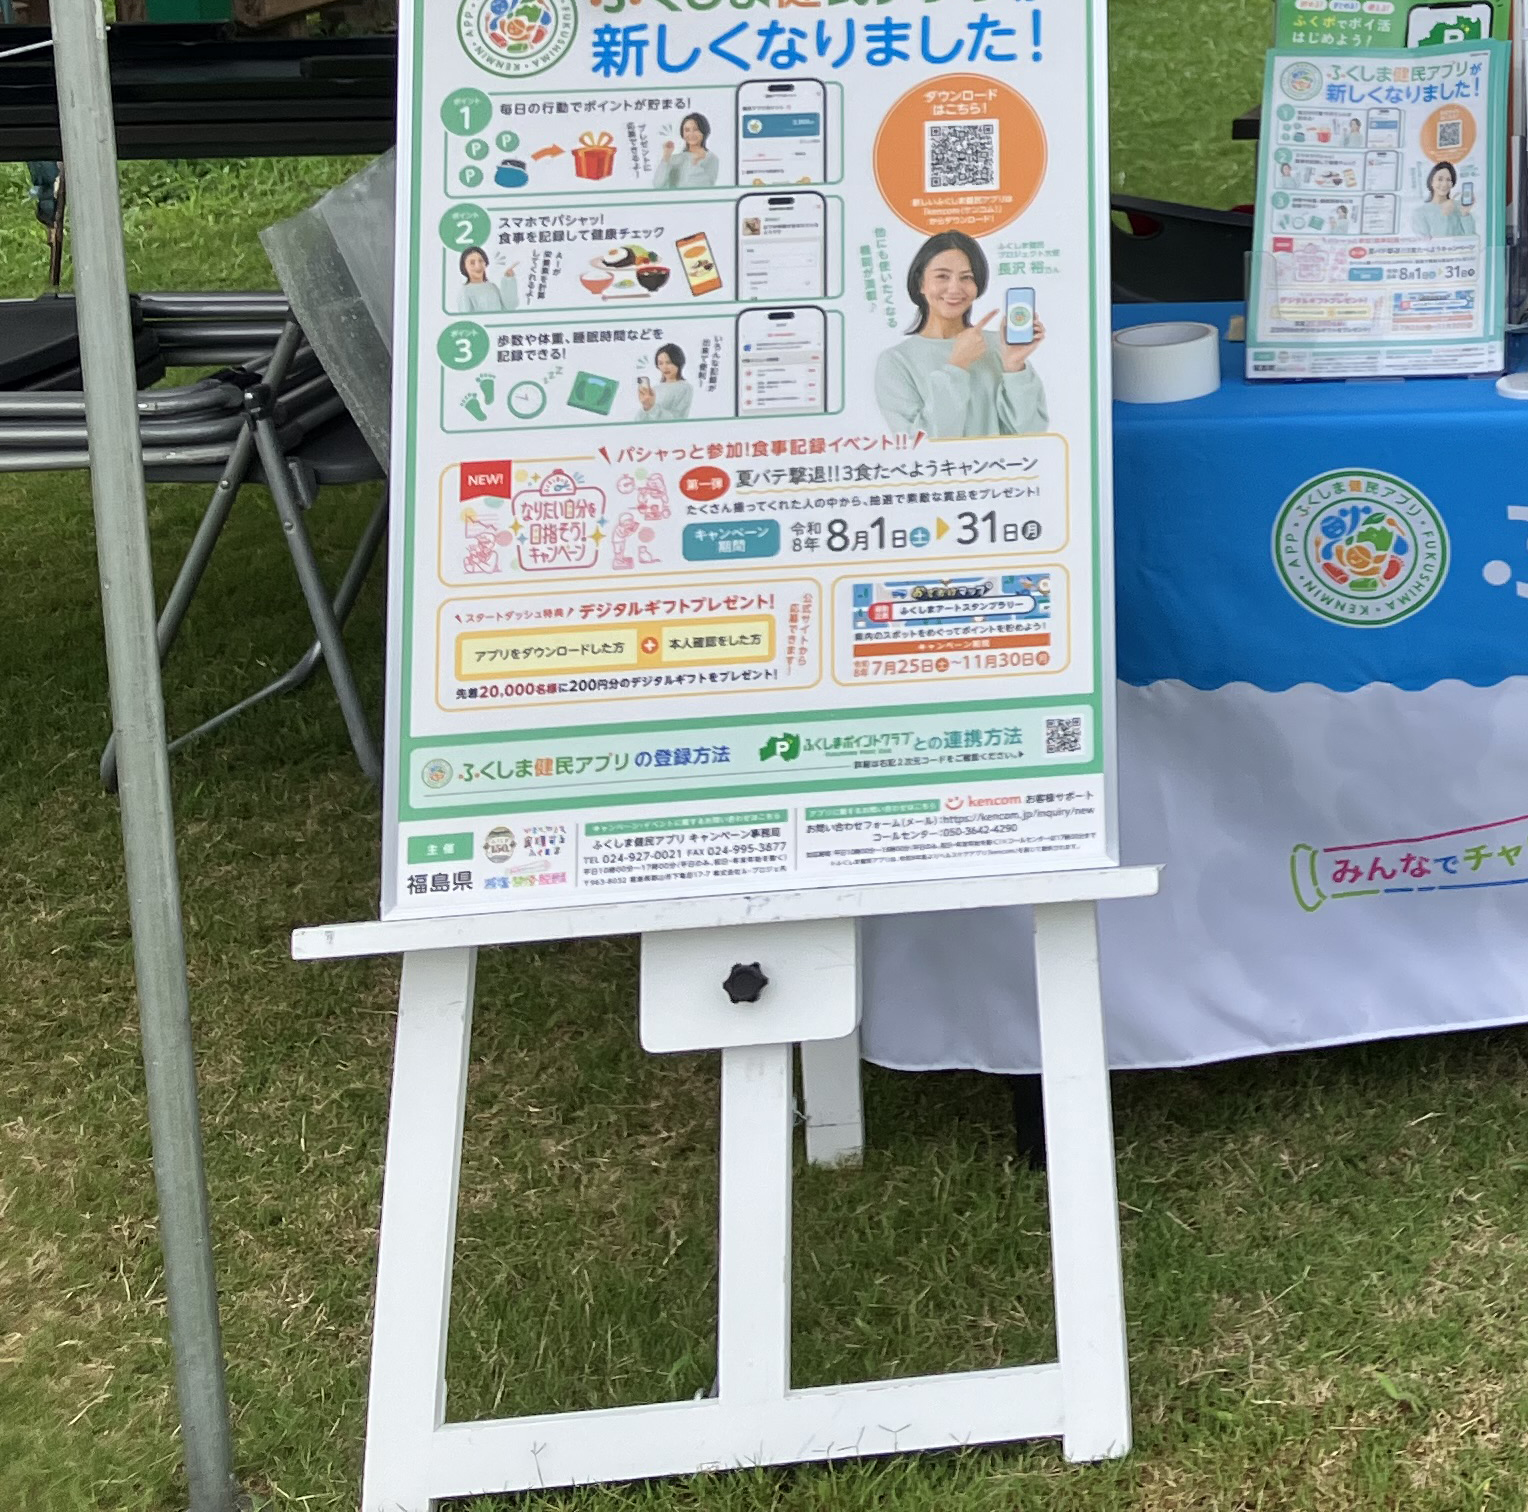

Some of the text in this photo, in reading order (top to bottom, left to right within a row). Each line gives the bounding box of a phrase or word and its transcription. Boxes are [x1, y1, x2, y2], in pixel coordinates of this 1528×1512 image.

[592, 9, 1043, 78] 新しくなりました!
[923, 88, 998, 103] ダウンロード
[1326, 77, 1480, 104] 新しくなりました!
[459, 106, 470, 130] 1
[500, 98, 692, 116] 毎日の行動でポイントが貯まる!
[932, 102, 988, 116] はこちら!
[455, 220, 474, 245] 2
[454, 339, 473, 363] 3
[467, 473, 504, 487] NEW!
[1296, 479, 1422, 518] ふくしま健民アプリ
[694, 526, 770, 542] キャンペーン
[791, 521, 822, 536] 令和
[1286, 533, 1302, 569] APP
[1385, 530, 1437, 611] FUKUSHIMA
[1303, 579, 1370, 616] KENMIN
[475, 641, 625, 662] アプリをダウンロードした方
[968, 795, 1021, 807] kencom
[406, 870, 474, 895] 福島県
